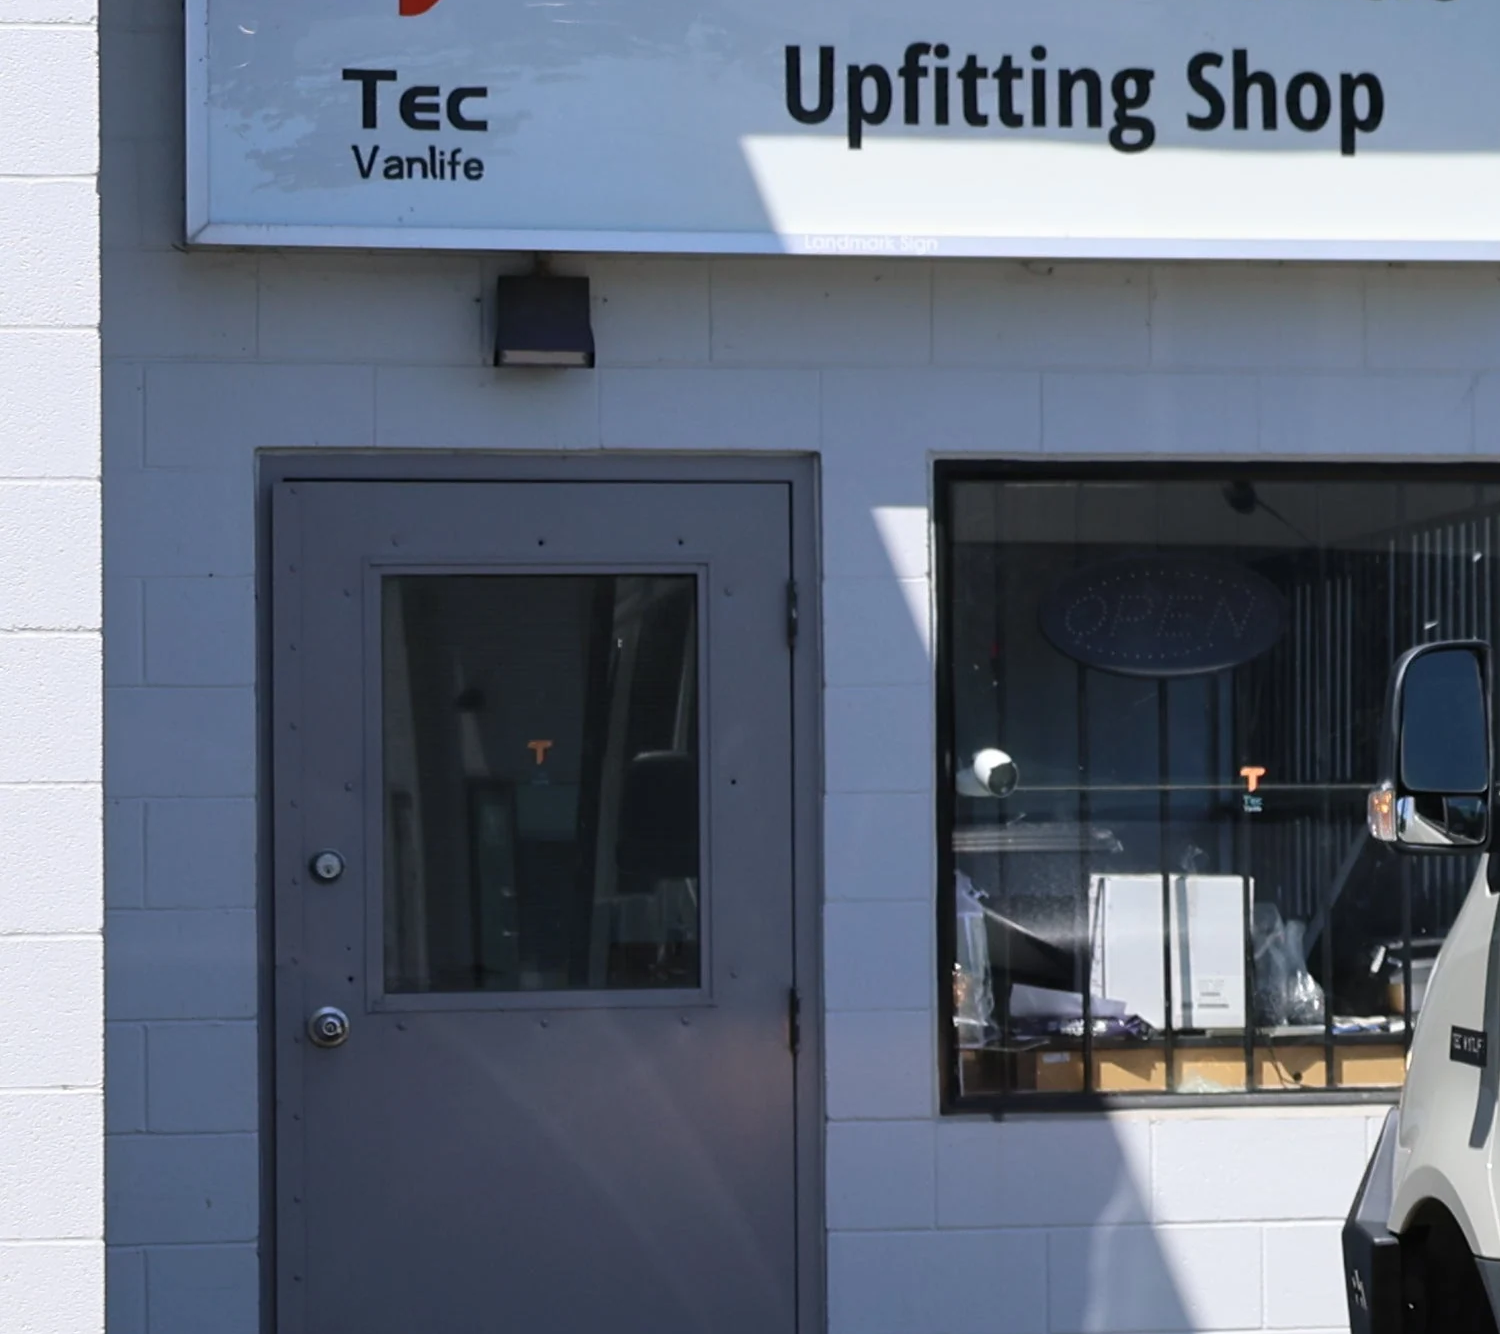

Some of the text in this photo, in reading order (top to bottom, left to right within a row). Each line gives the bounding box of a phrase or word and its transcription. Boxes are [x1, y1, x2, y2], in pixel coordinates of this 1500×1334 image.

[783, 41, 1386, 157] Upfitting Shop
[350, 143, 486, 182] Vanlife
[803, 233, 939, 255] Landmark Sign
[1066, 593, 1257, 638] OPEN
